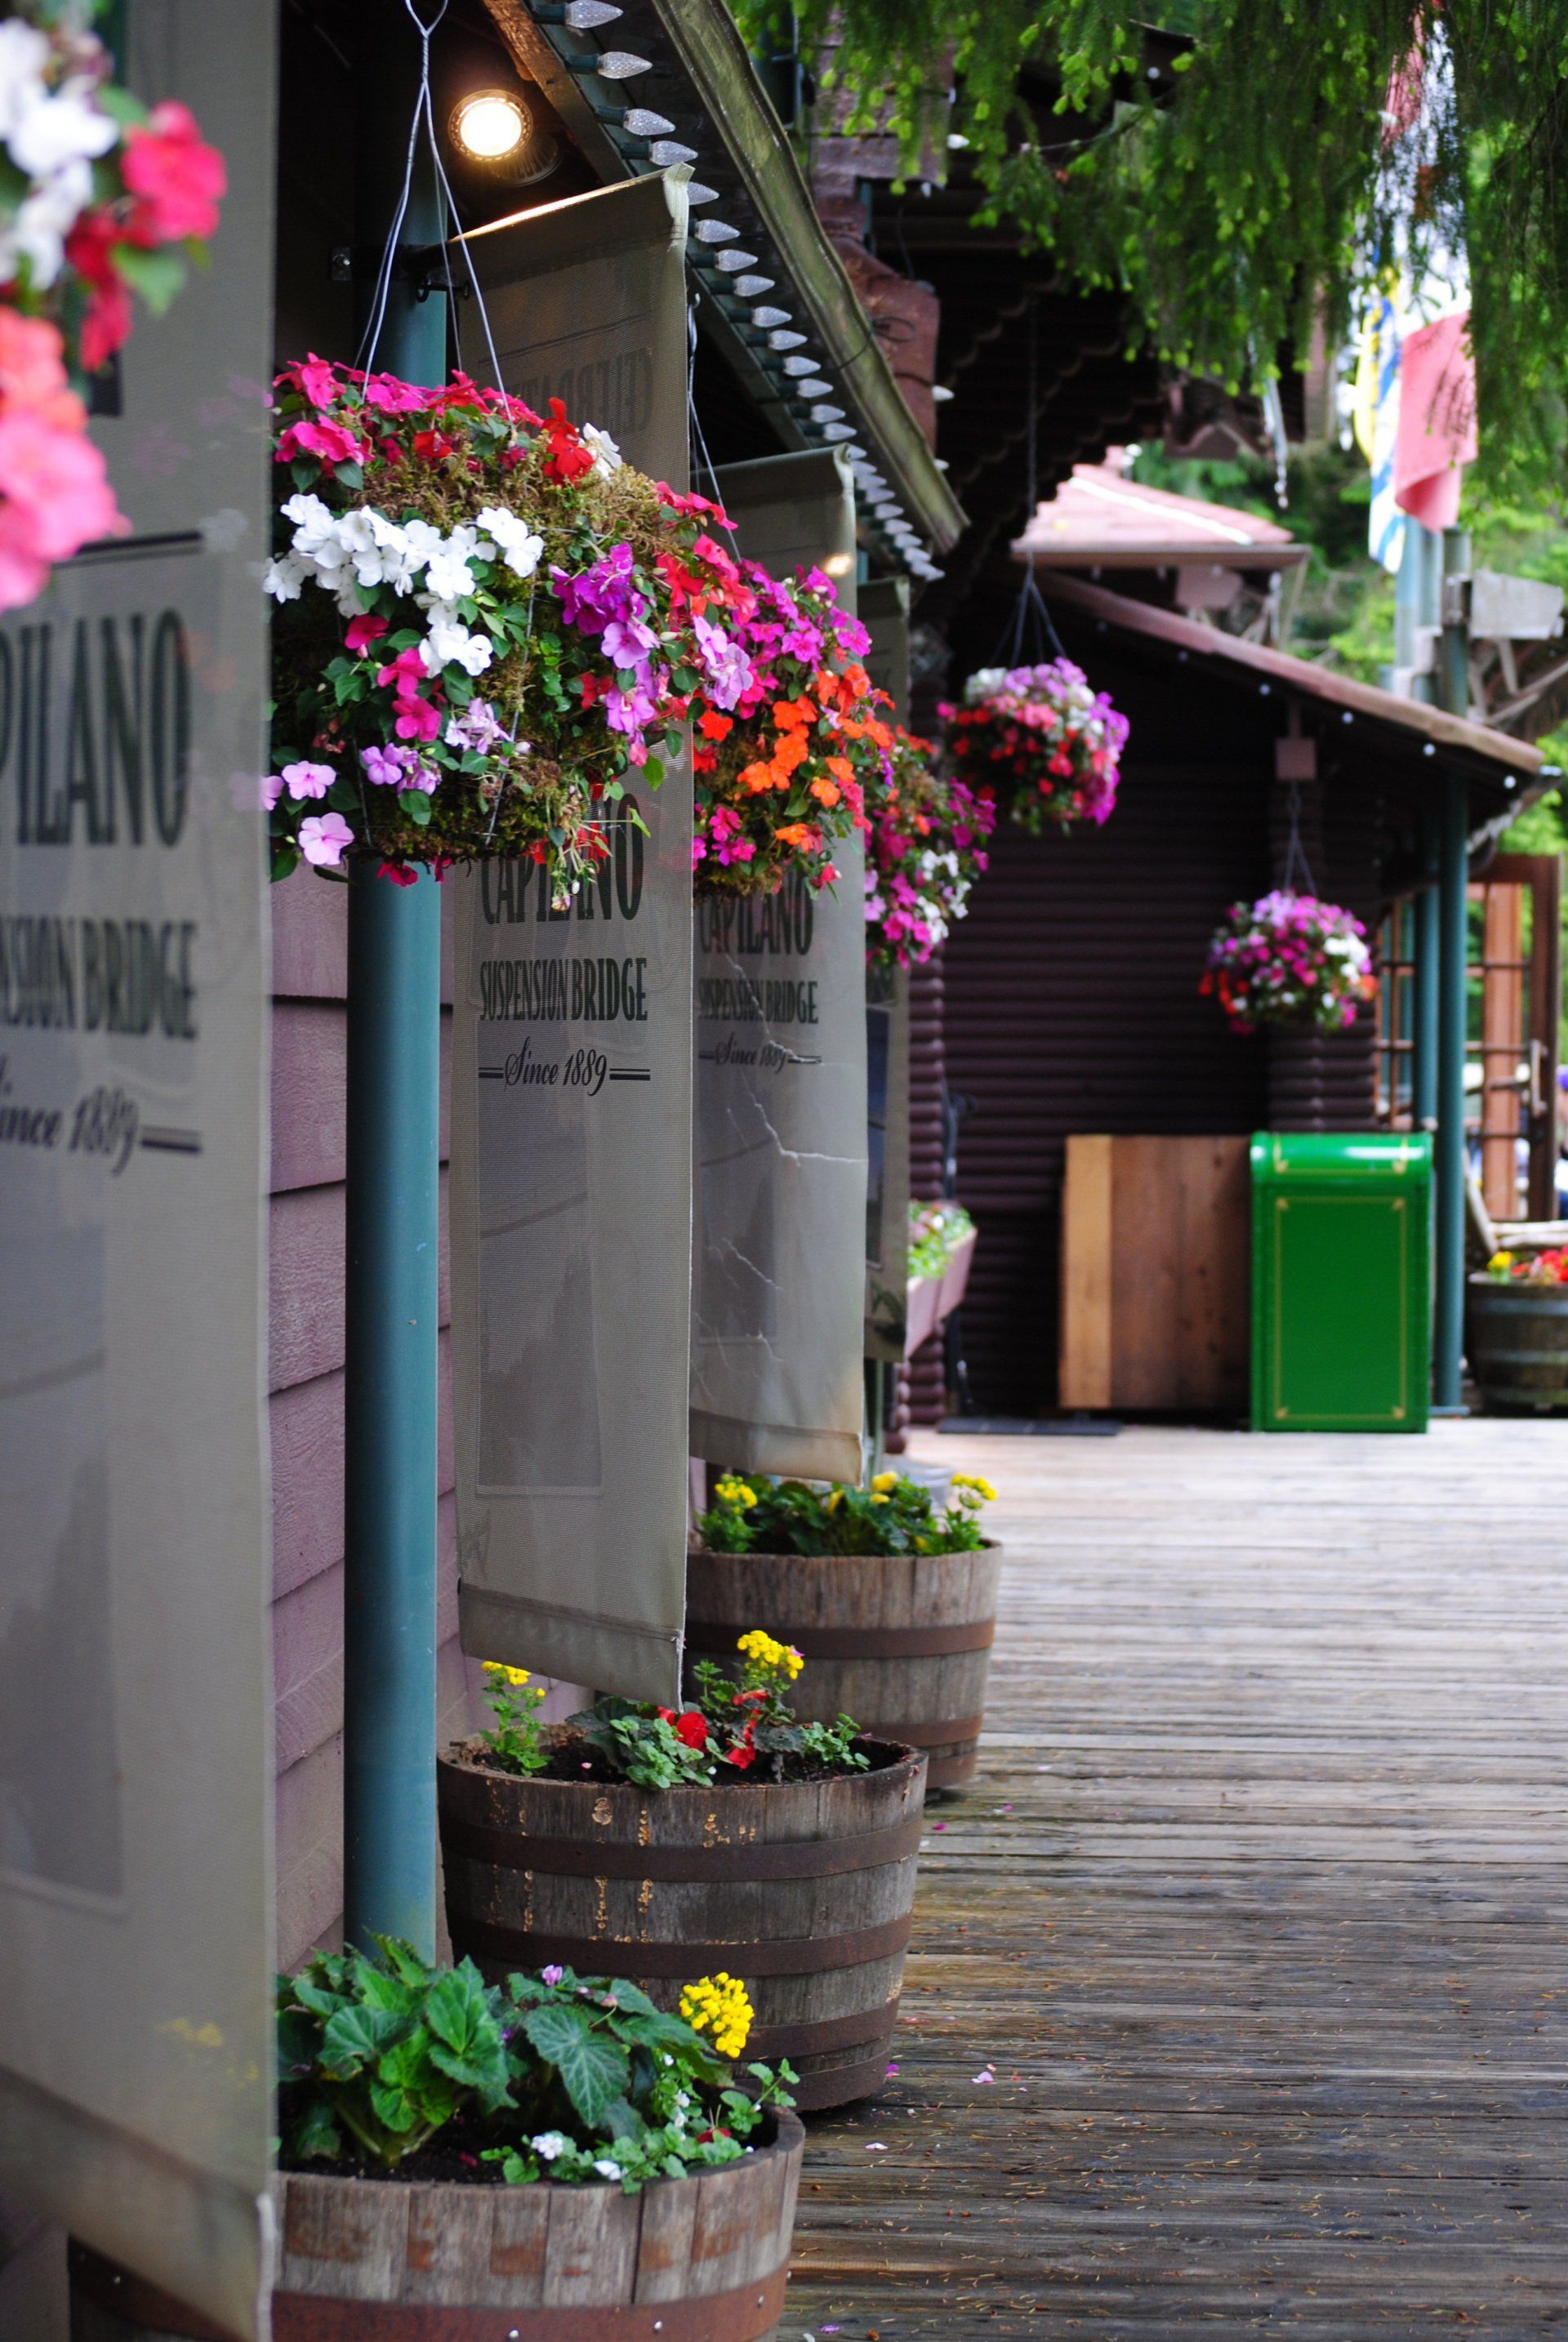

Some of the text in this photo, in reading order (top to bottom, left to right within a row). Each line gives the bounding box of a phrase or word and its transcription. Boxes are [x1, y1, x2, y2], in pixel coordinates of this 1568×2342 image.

[480, 793, 644, 924] CAPIANO
[479, 957, 648, 1022] SUSPENSION BRIDGE
[765, 981, 819, 1024] BRIDGE
[504, 1035, 608, 1097] Since 1889
[715, 1031, 758, 1065] Since
